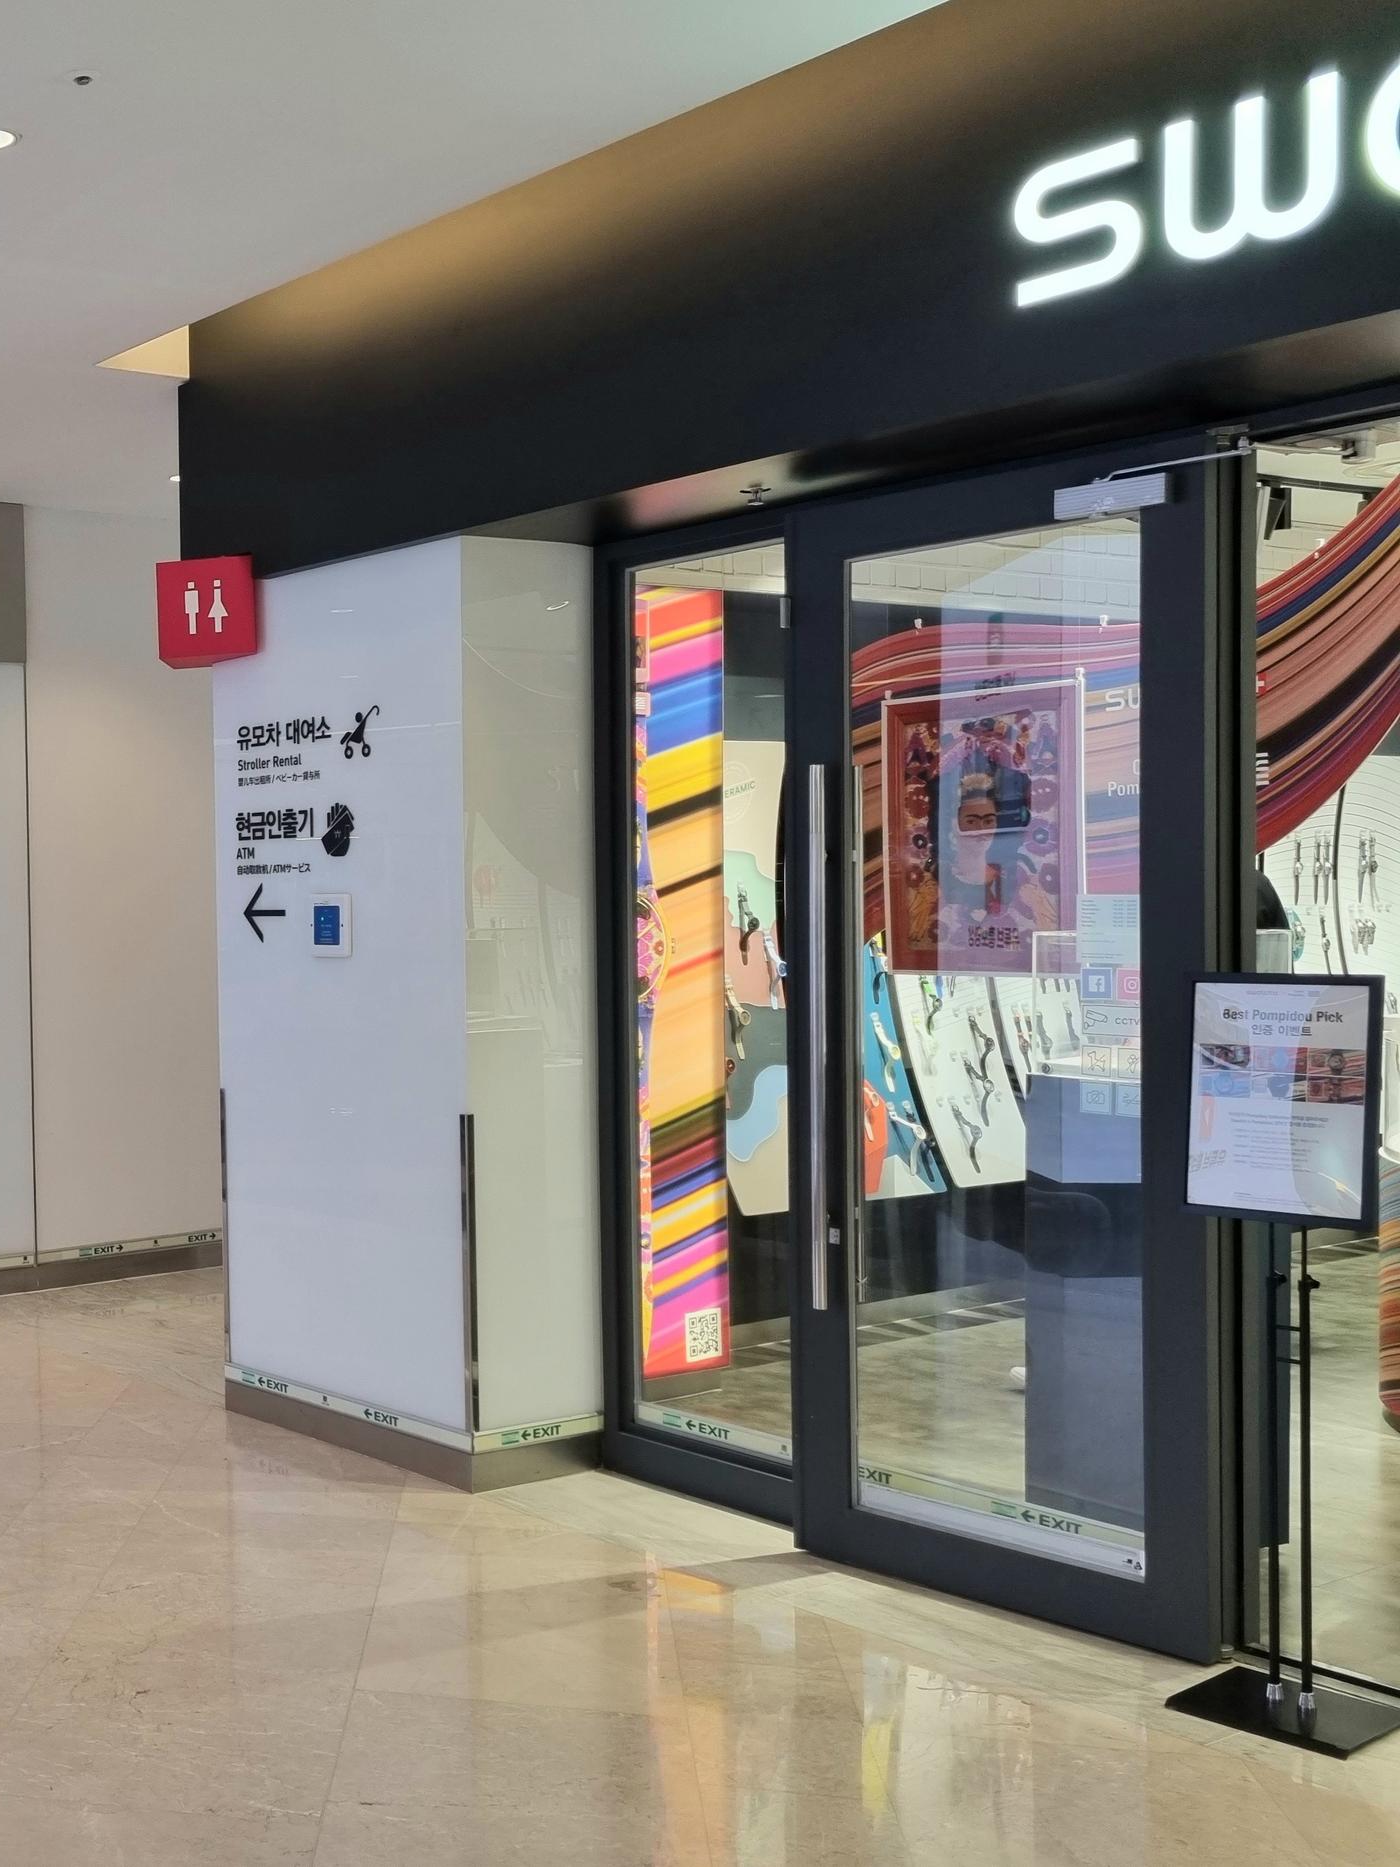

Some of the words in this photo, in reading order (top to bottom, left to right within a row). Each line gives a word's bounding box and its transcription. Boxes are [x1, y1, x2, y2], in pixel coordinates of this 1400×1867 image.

[237, 721, 281, 750] 유모차
[285, 716, 332, 745] 대여소
[237, 757, 271, 771] Stroller
[272, 753, 302, 768] Rental
[236, 807, 314, 841] 현금인출기
[236, 847, 255, 860] ATM
[1223, 1008, 1249, 1020] Best
[1252, 1009, 1312, 1023] Pompidou
[1316, 1010, 1343, 1023] Pick
[1251, 1024, 1273, 1036] 인증
[1279, 1025, 1312, 1037] 이벤트
[188, 1233, 208, 1243] EXIT
[94, 1245, 115, 1255] EXIT
[266, 1378, 289, 1394] EXIT
[373, 1410, 399, 1427] EXIT
[532, 1424, 561, 1439] EXIT
[698, 1423, 730, 1440] EXIT
[1039, 1514, 1082, 1534] EXIT
